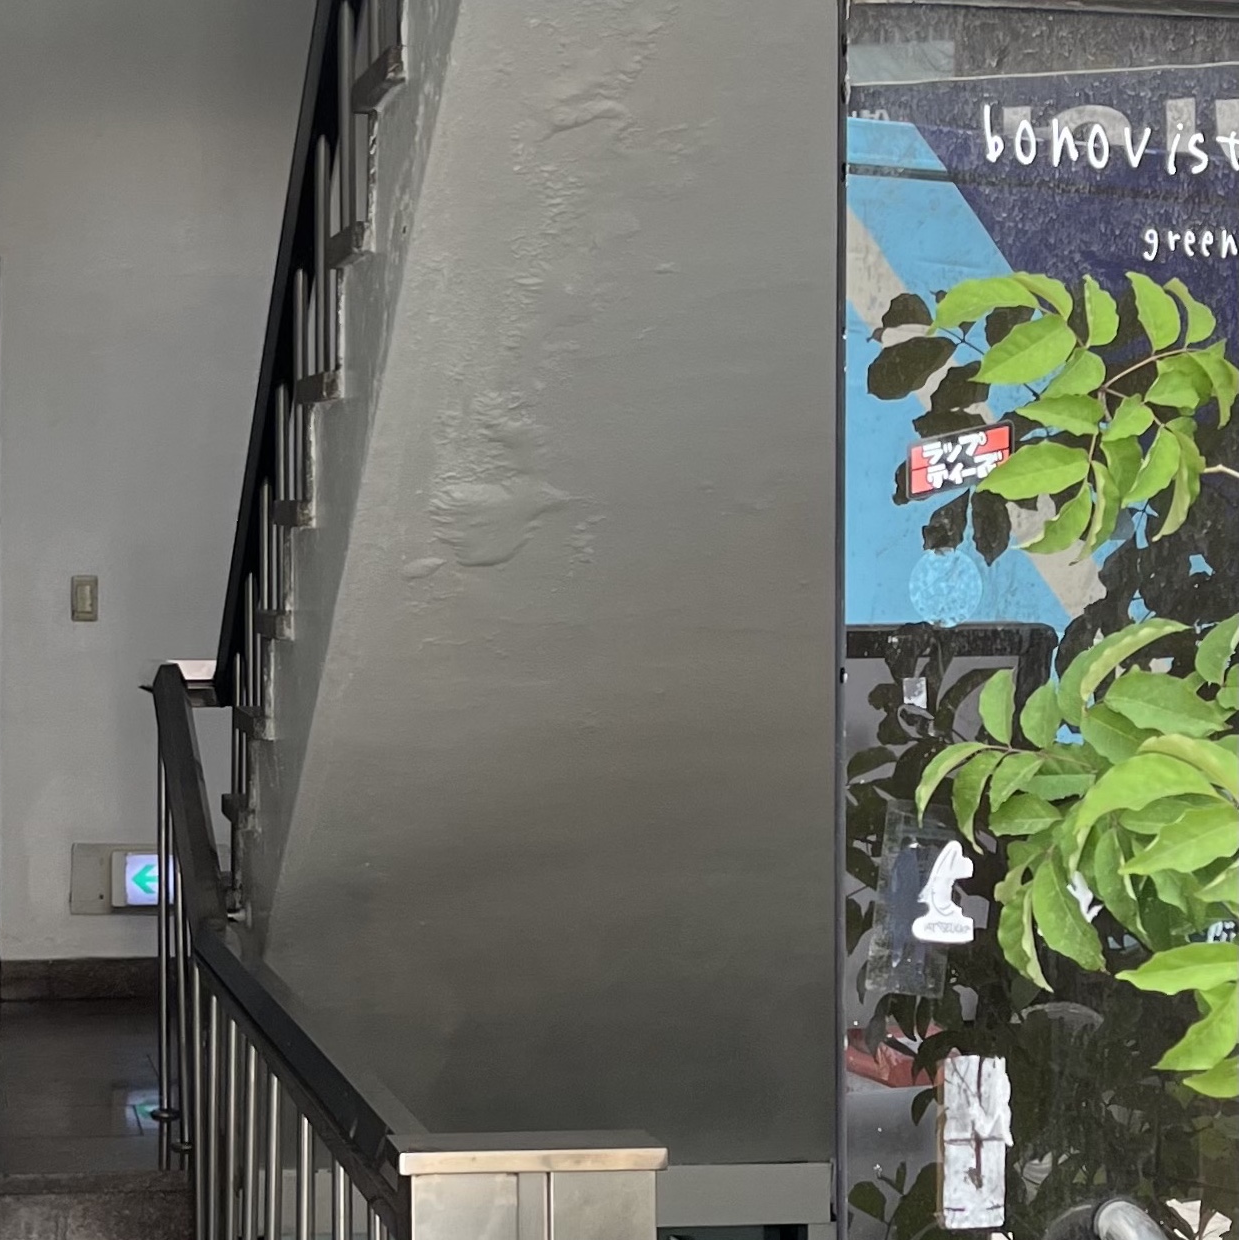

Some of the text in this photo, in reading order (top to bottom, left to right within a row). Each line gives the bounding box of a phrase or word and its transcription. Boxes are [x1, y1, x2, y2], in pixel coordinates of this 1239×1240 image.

[1142, 228, 1238, 261] green
[922, 431, 987, 465] ラップ
